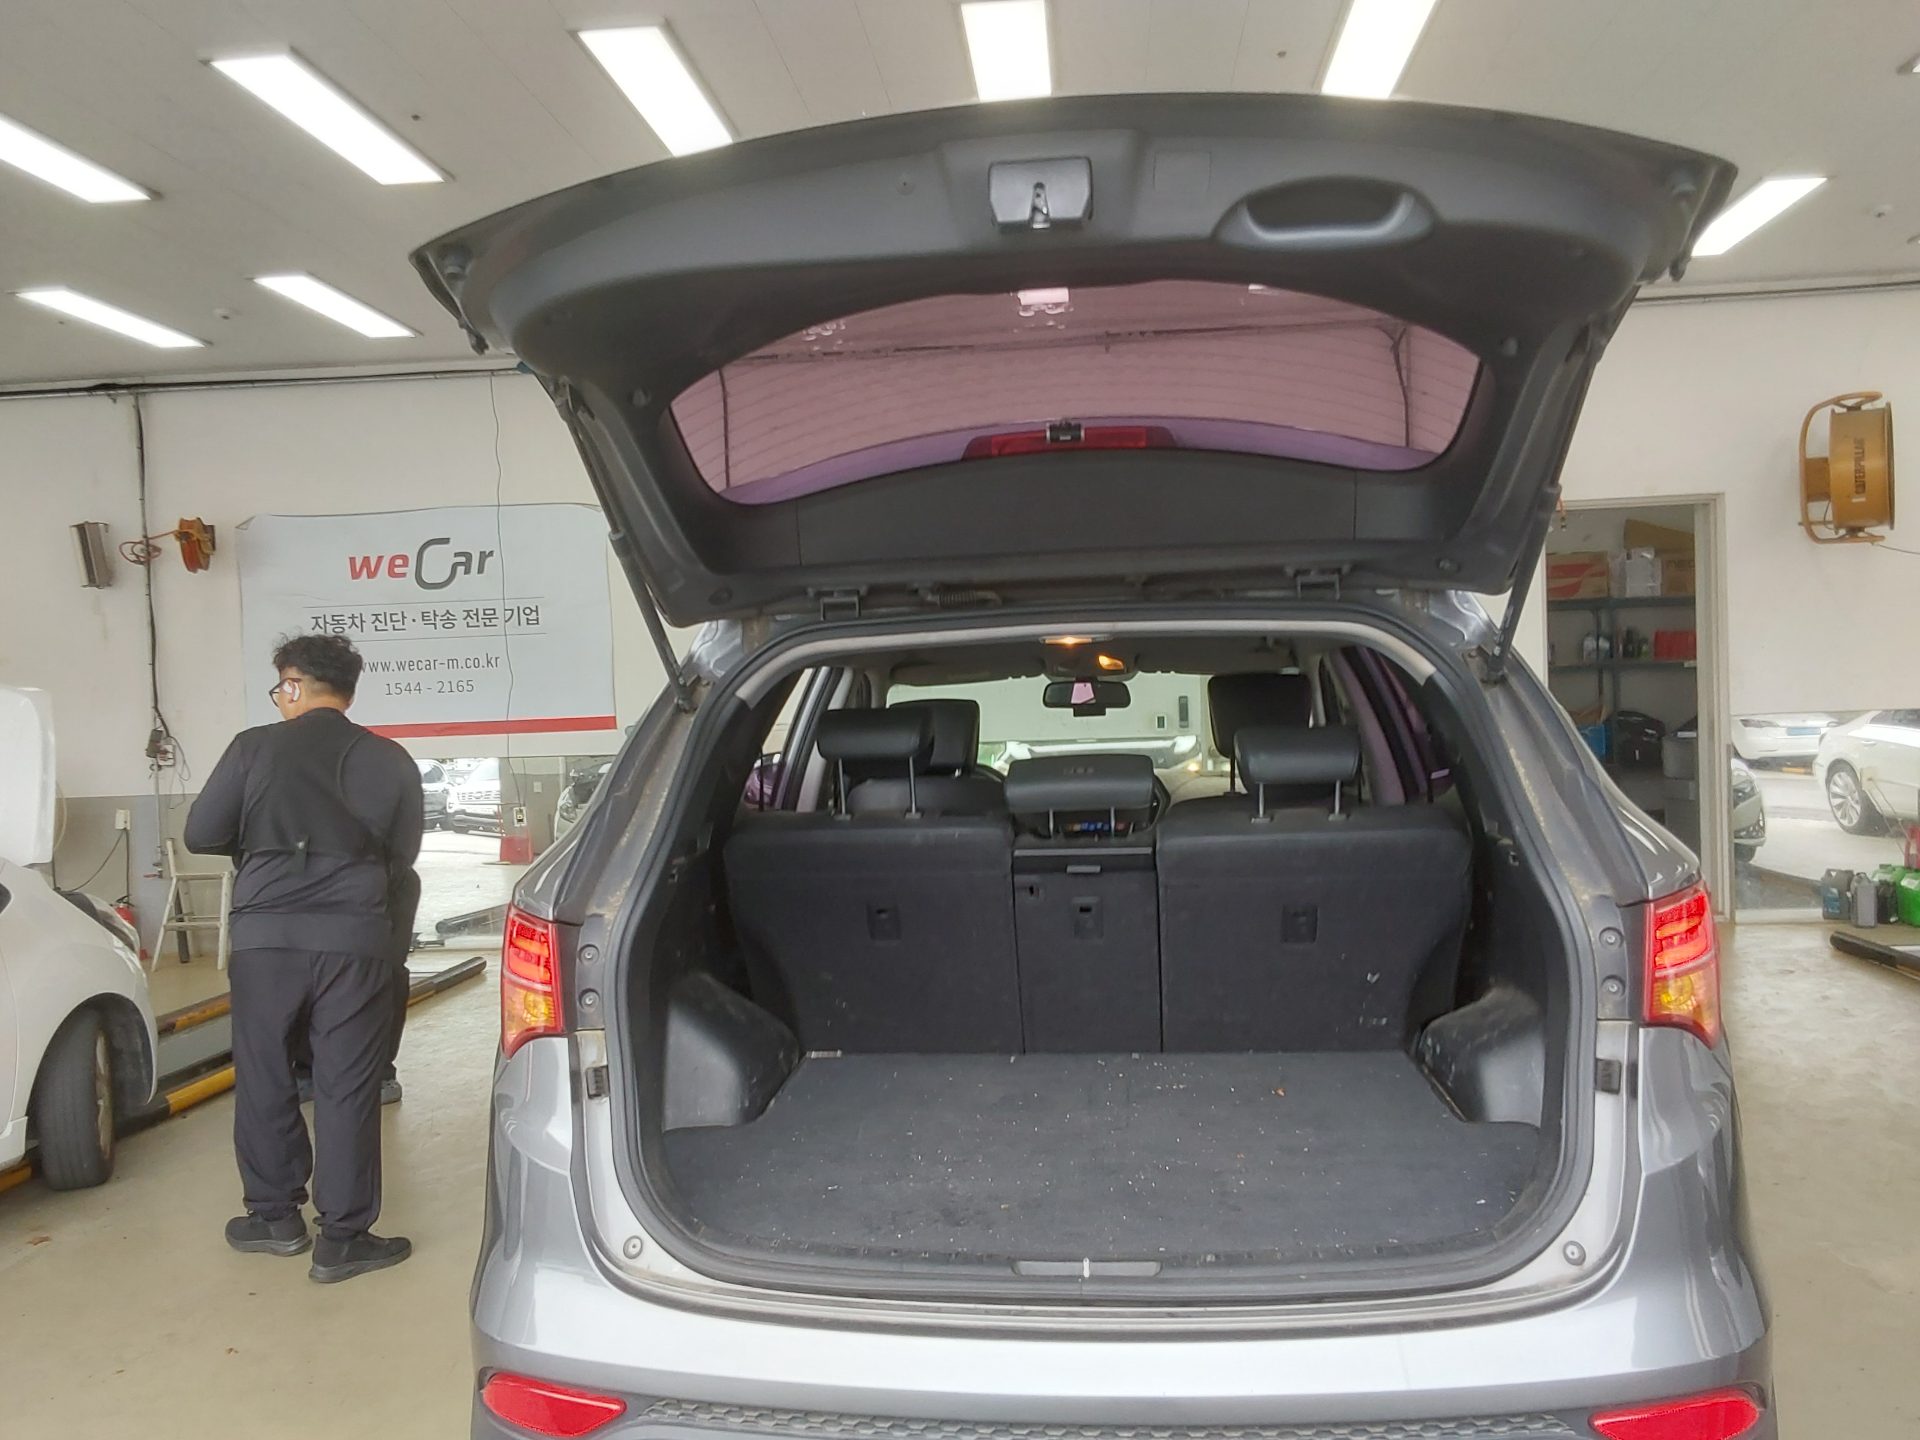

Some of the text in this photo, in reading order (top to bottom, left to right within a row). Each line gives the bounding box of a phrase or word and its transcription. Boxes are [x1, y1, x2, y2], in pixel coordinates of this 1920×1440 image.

[311, 611, 366, 635] 자동차
[462, 607, 500, 629] 전문
[504, 604, 540, 627] 기업
